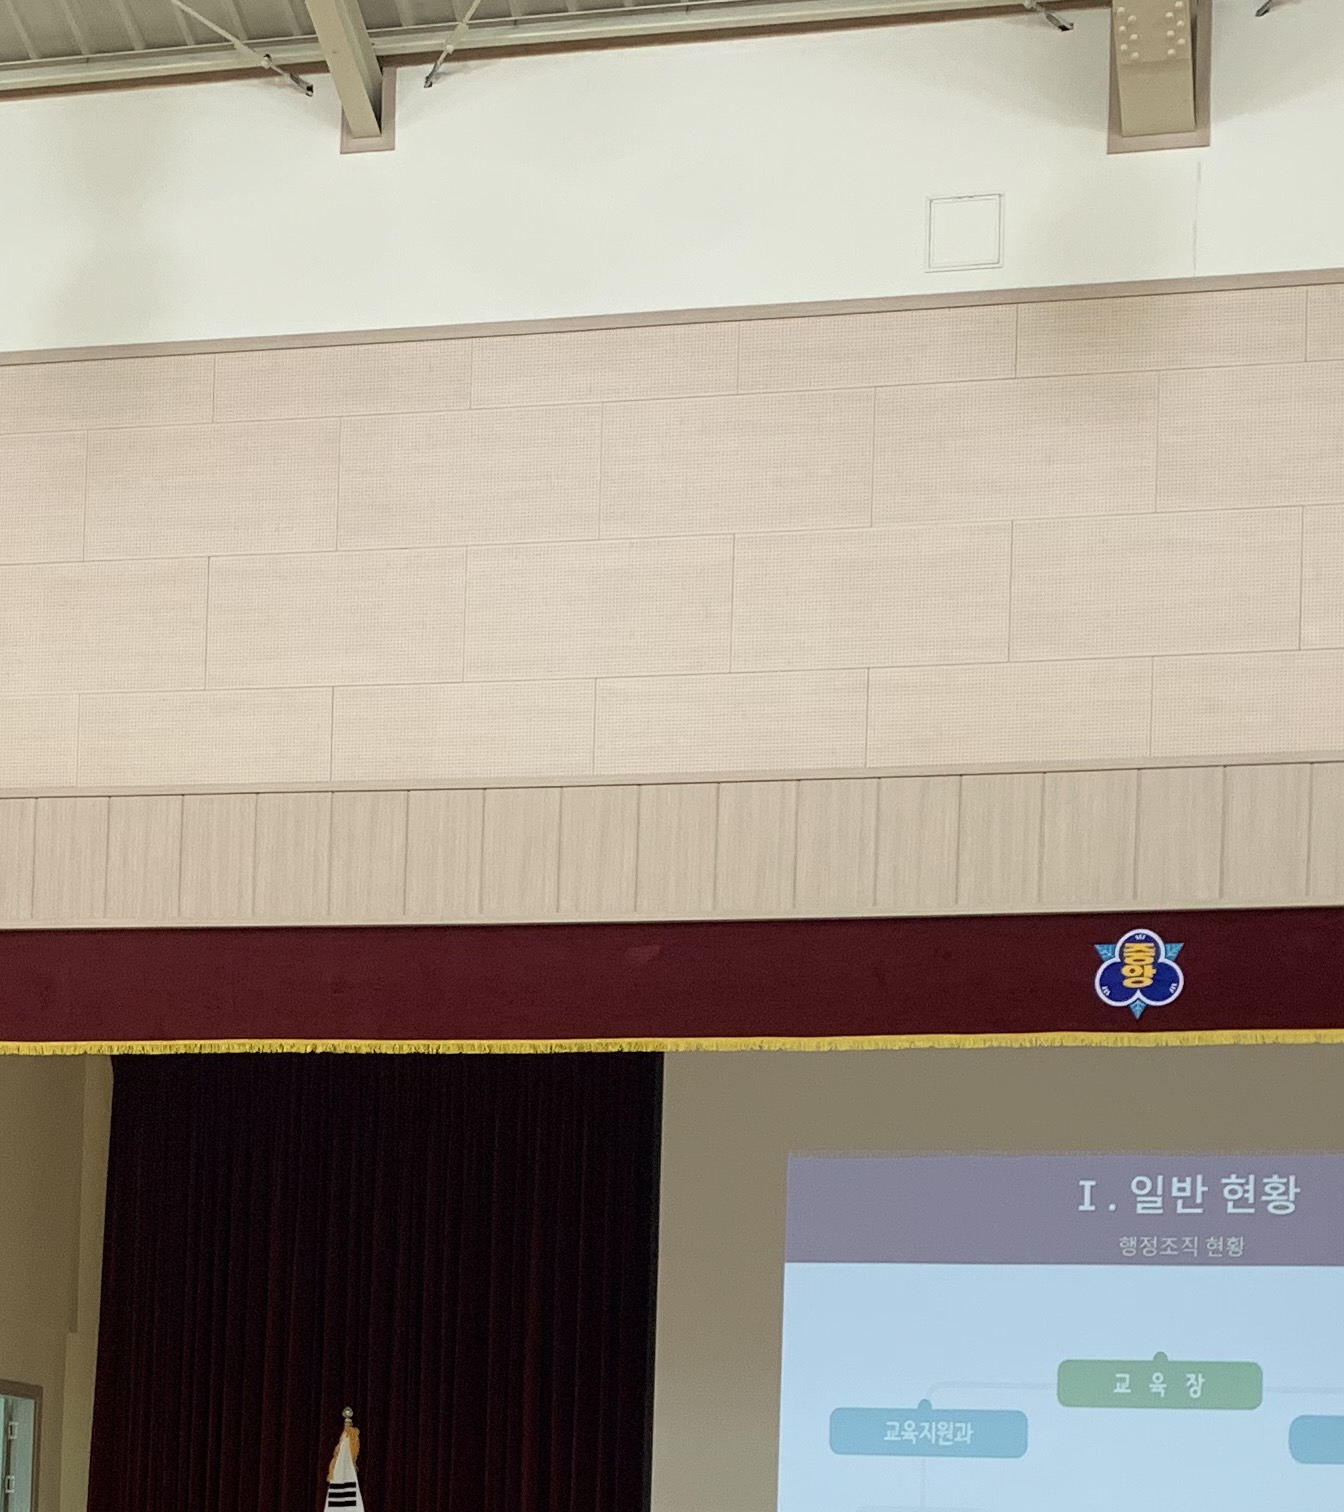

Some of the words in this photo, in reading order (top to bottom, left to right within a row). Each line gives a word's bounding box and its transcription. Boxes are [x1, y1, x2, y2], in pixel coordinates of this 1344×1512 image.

[1131, 1174, 1209, 1215] 일반
[1221, 1174, 1301, 1215] 현황
[1119, 1236, 1198, 1257] 행정조직
[1206, 1236, 1245, 1257] 현황
[883, 1421, 974, 1445] 교육지원과
